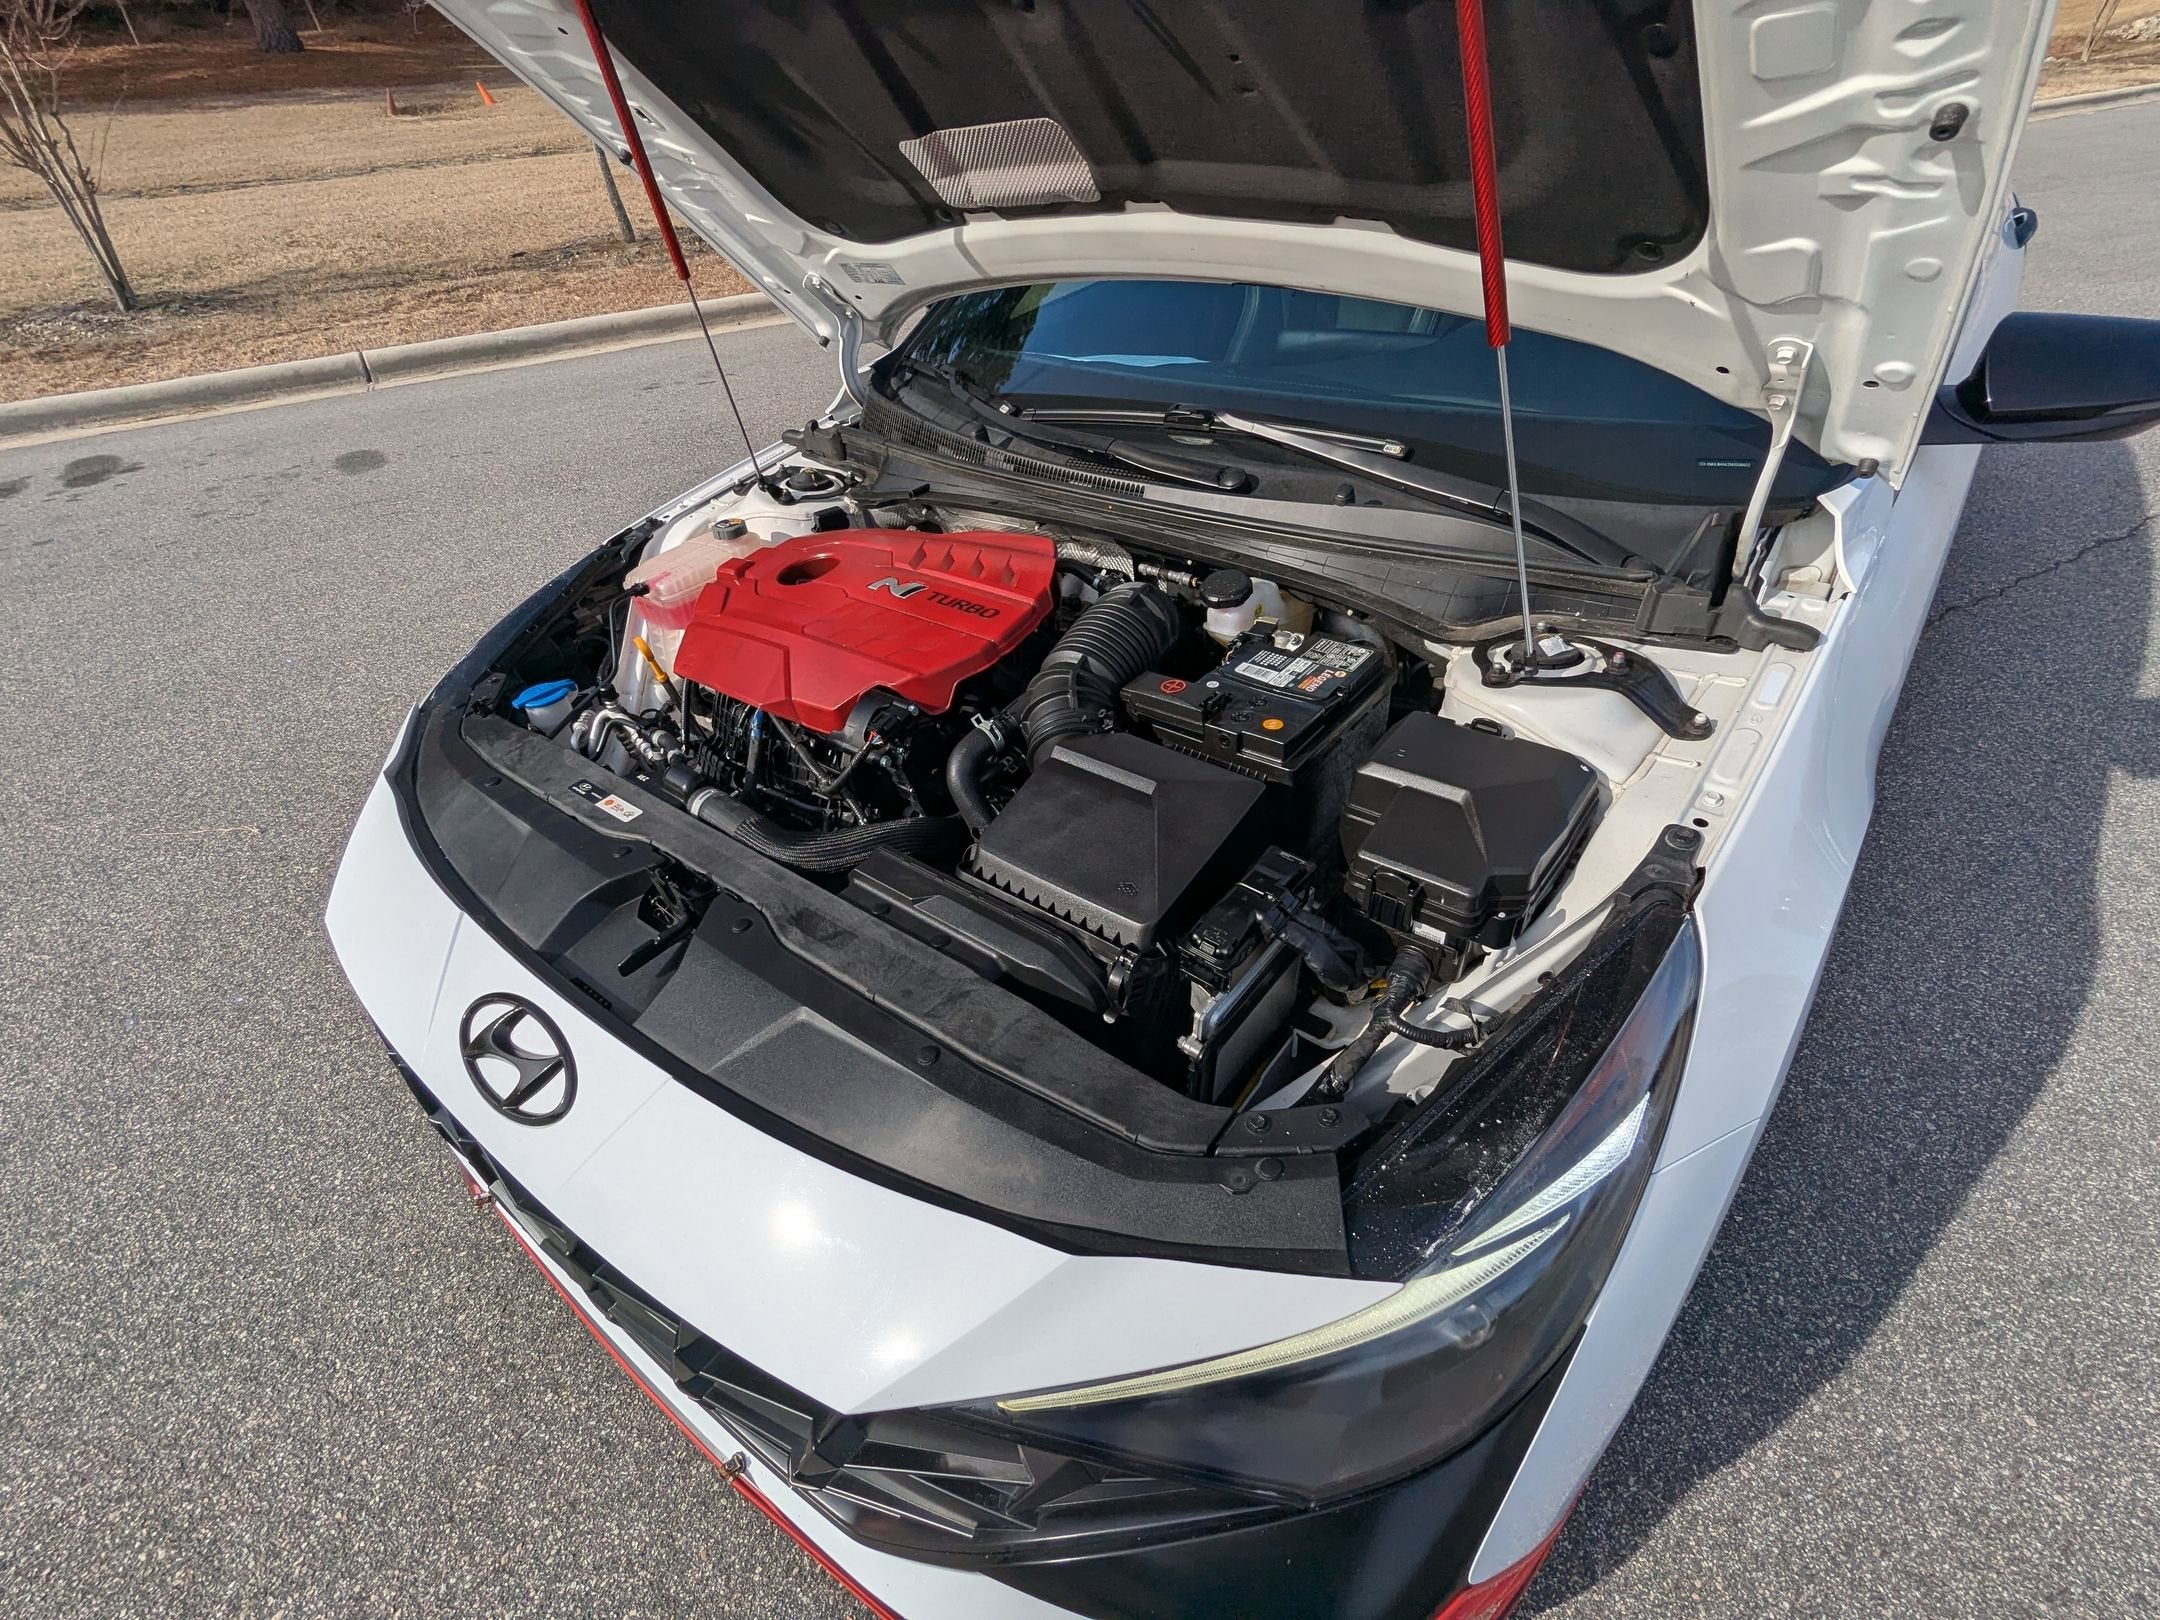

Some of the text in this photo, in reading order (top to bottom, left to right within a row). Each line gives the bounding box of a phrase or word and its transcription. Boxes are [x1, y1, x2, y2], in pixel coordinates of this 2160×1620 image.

[867, 576, 1000, 619] N TURBO
[1305, 669, 1335, 693] LEGEND
